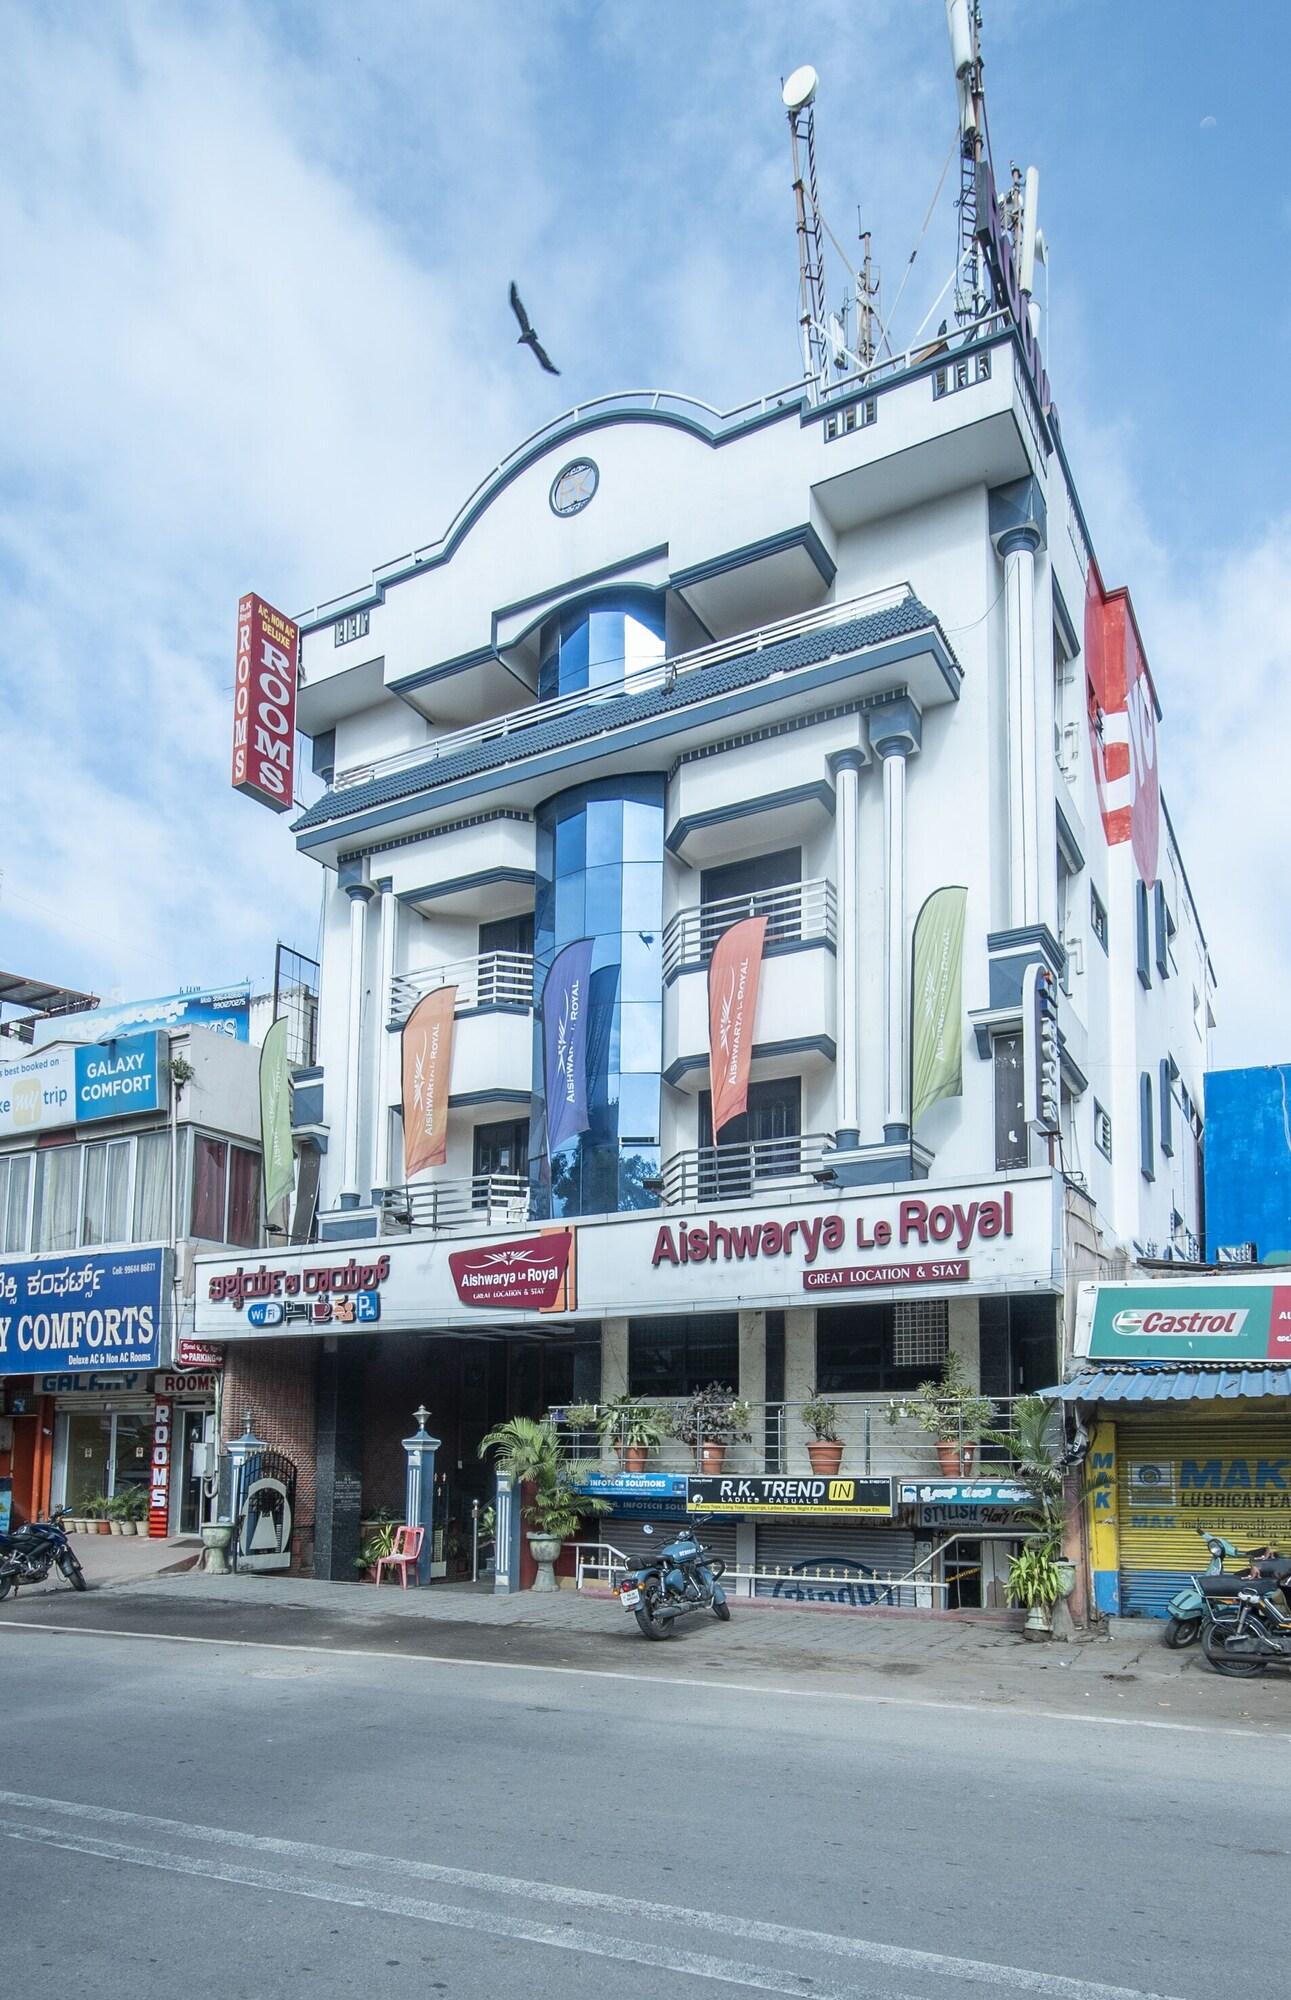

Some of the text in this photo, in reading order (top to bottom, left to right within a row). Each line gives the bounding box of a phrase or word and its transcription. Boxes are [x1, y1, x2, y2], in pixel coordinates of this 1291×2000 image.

[271, 613, 285, 631] NON
[262, 620, 290, 649] DELUXE
[235, 626, 250, 778] ROOMS
[254, 639, 292, 794] ROOMS
[571, 979, 579, 1020] ROYAL
[430, 1024, 440, 1060] ROYAL
[4, 1066, 19, 1076] best
[21, 1059, 48, 1073] booked
[50, 1058, 59, 1066] on
[87, 1053, 145, 1078] GALAXY
[43, 1085, 67, 1107] trip
[81, 1074, 152, 1101] COMFORT
[652, 1190, 1014, 1266] Aishwarya Le Royal
[461, 1266, 558, 1288] Aishwarya Le Royal
[807, 1263, 962, 1285] GREAT LOCATION & STAY
[251, 1309, 275, 1320] Wi Fi
[1142, 1311, 1237, 1333] Castrol
[18, 1306, 153, 1351] COMFORTS
[68, 1354, 88, 1365] Deluxe
[90, 1353, 99, 1364] AC
[106, 1353, 118, 1363] Non
[120, 1352, 128, 1362] AC
[130, 1352, 151, 1362] Rooms
[188, 1353, 216, 1363] PARKING
[42, 1373, 138, 1392] GALAY
[165, 1375, 216, 1392] ROOMS
[151, 1405, 169, 1508] ROOMS
[625, 1480, 666, 1488] SOLUTIONS
[1180, 1459, 1291, 1489] MAK
[720, 1480, 852, 1498] R.K. TREND IN
[721, 1496, 759, 1504] LADIES
[924, 1503, 977, 1523] STYLISH
